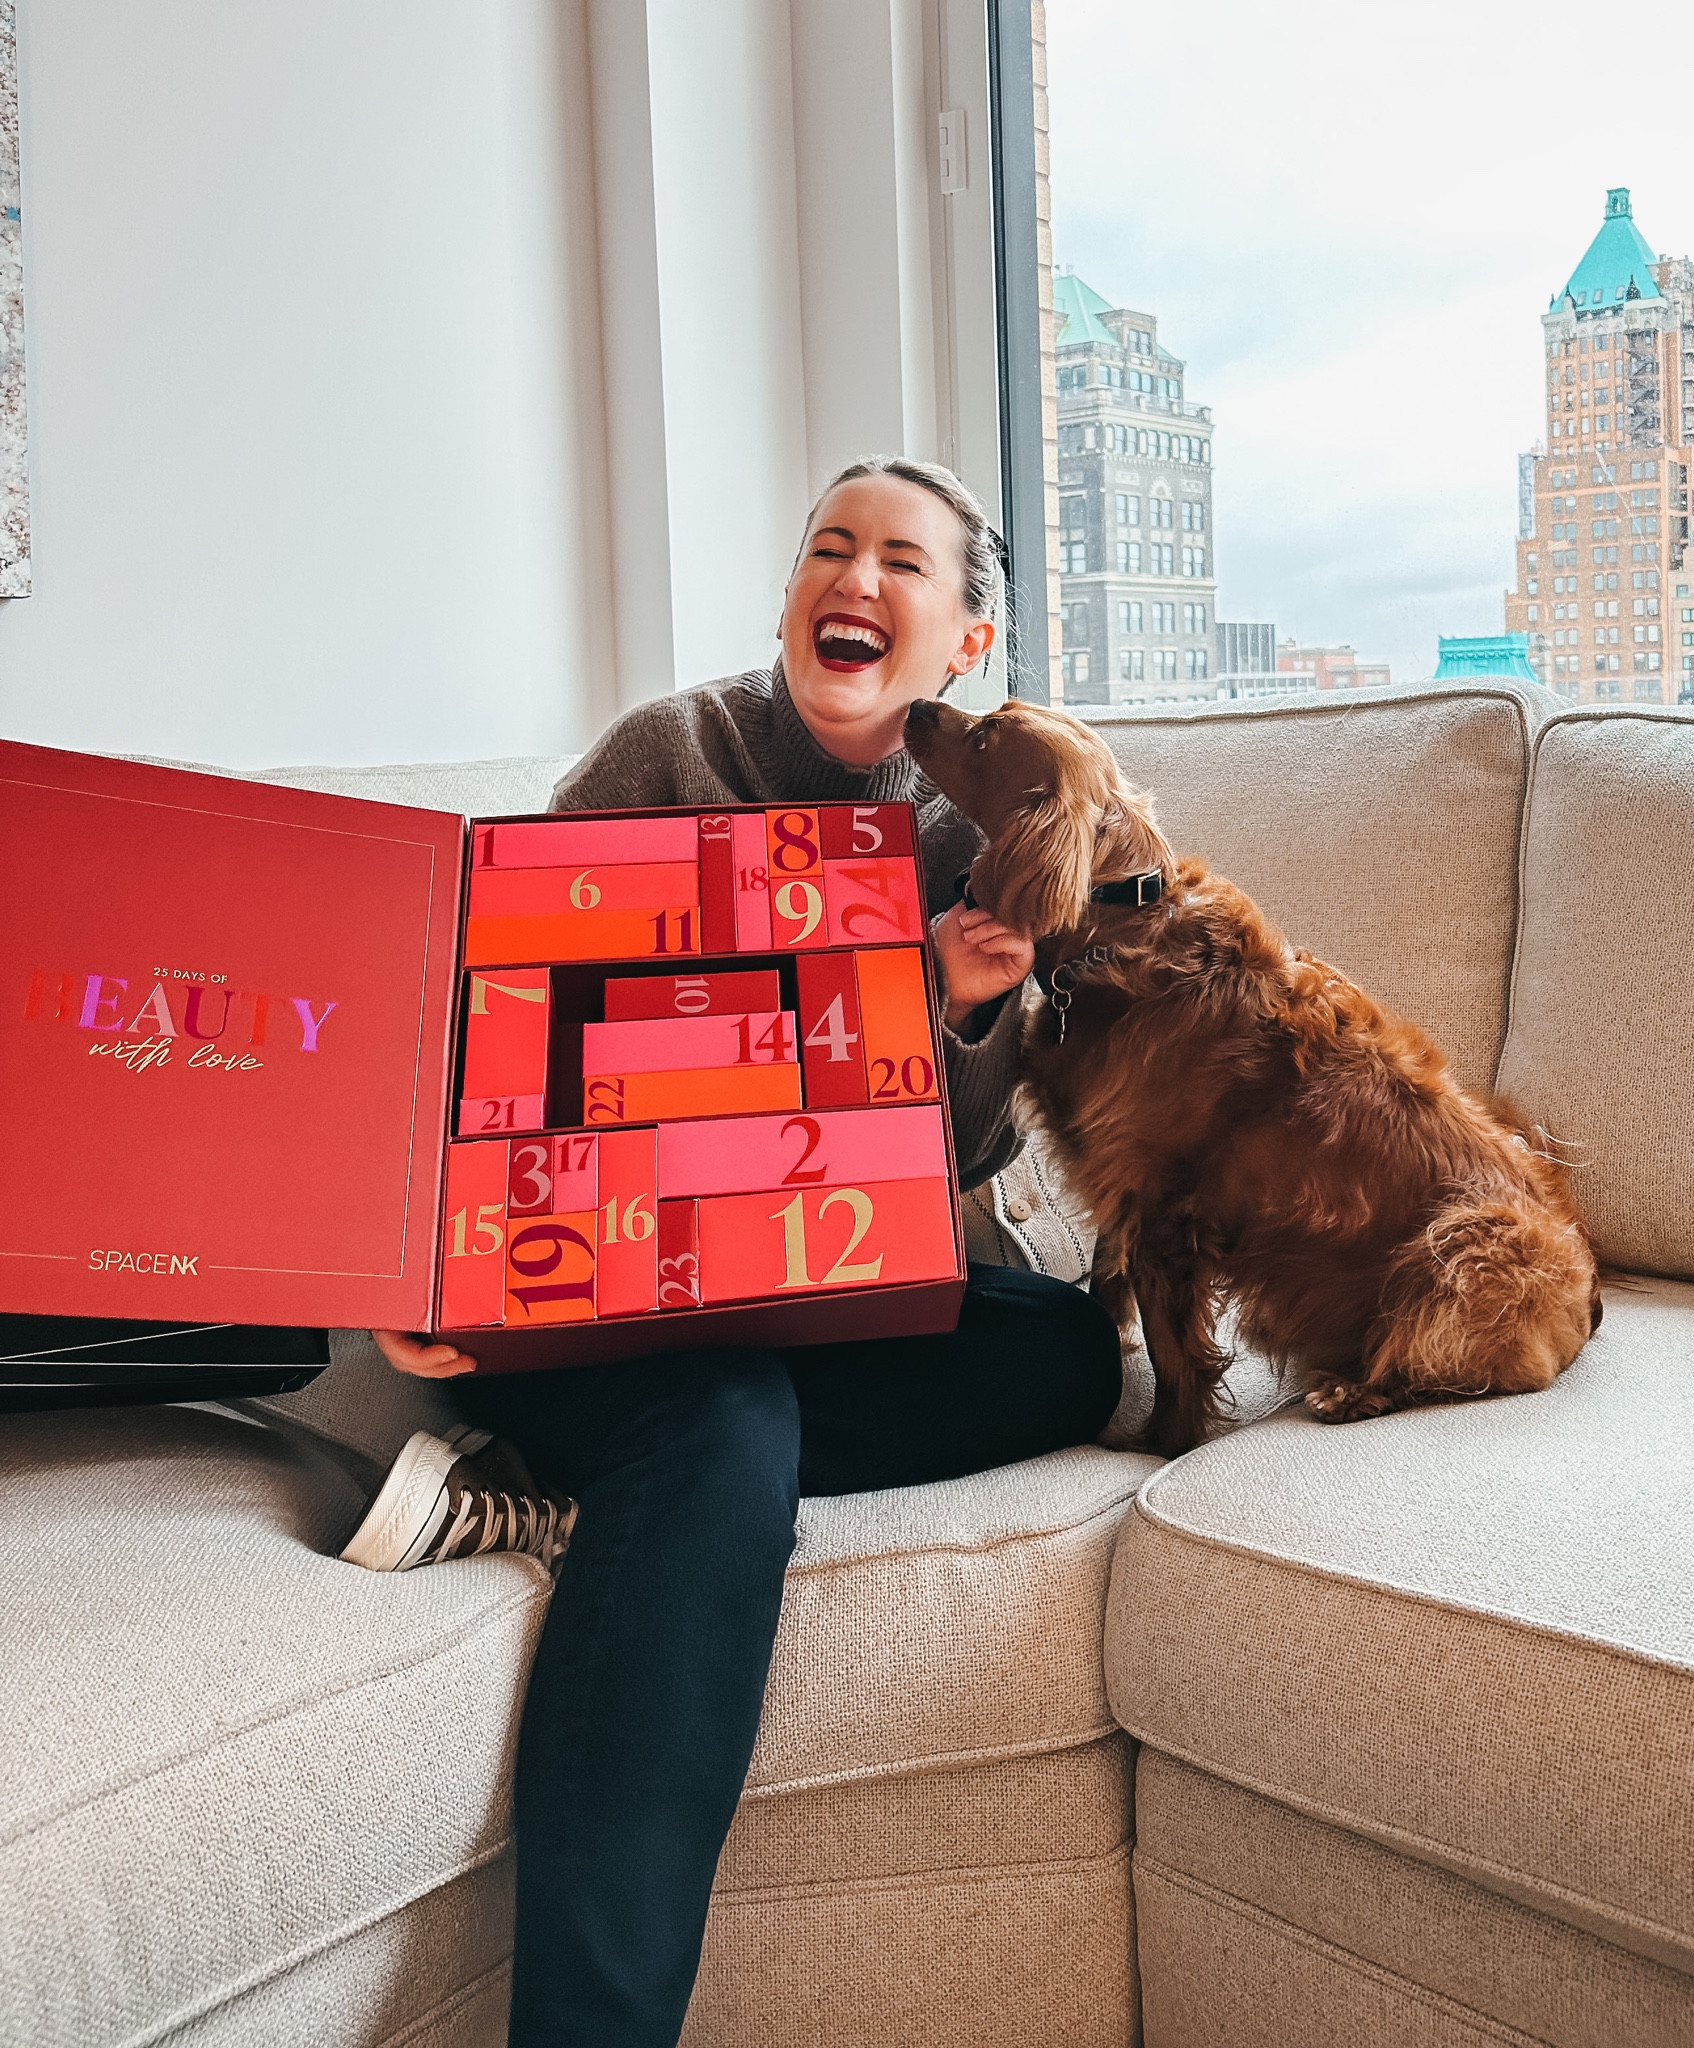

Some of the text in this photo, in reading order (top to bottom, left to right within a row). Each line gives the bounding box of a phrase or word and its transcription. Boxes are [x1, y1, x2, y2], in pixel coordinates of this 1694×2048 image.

[476, 827, 500, 867] 1
[701, 816, 731, 843] 13
[772, 812, 819, 872] 8
[852, 807, 883, 852] 5
[569, 870, 602, 910] 6
[738, 866, 768, 891] 18
[836, 858, 911, 938] 24
[648, 910, 698, 954] 11
[775, 881, 823, 945] 9
[153, 967, 228, 984] 25 DAYS OF
[471, 975, 546, 1015] 7
[674, 976, 710, 1014] 10
[23, 969, 339, 1052] BEAUTY
[804, 992, 859, 1062] 4
[89, 1036, 265, 1074] with love
[730, 1015, 793, 1063] 14
[588, 1078, 625, 1121] 22
[870, 1056, 933, 1099] 20
[481, 1099, 515, 1130] 21
[557, 1136, 597, 1173] 17
[780, 1116, 828, 1185] 2
[511, 1144, 551, 1208] 3
[446, 1203, 504, 1258] 15
[600, 1193, 655, 1245] 16
[768, 1187, 884, 1289] 12
[508, 1223, 596, 1317] 19
[659, 1251, 699, 1304] 23
